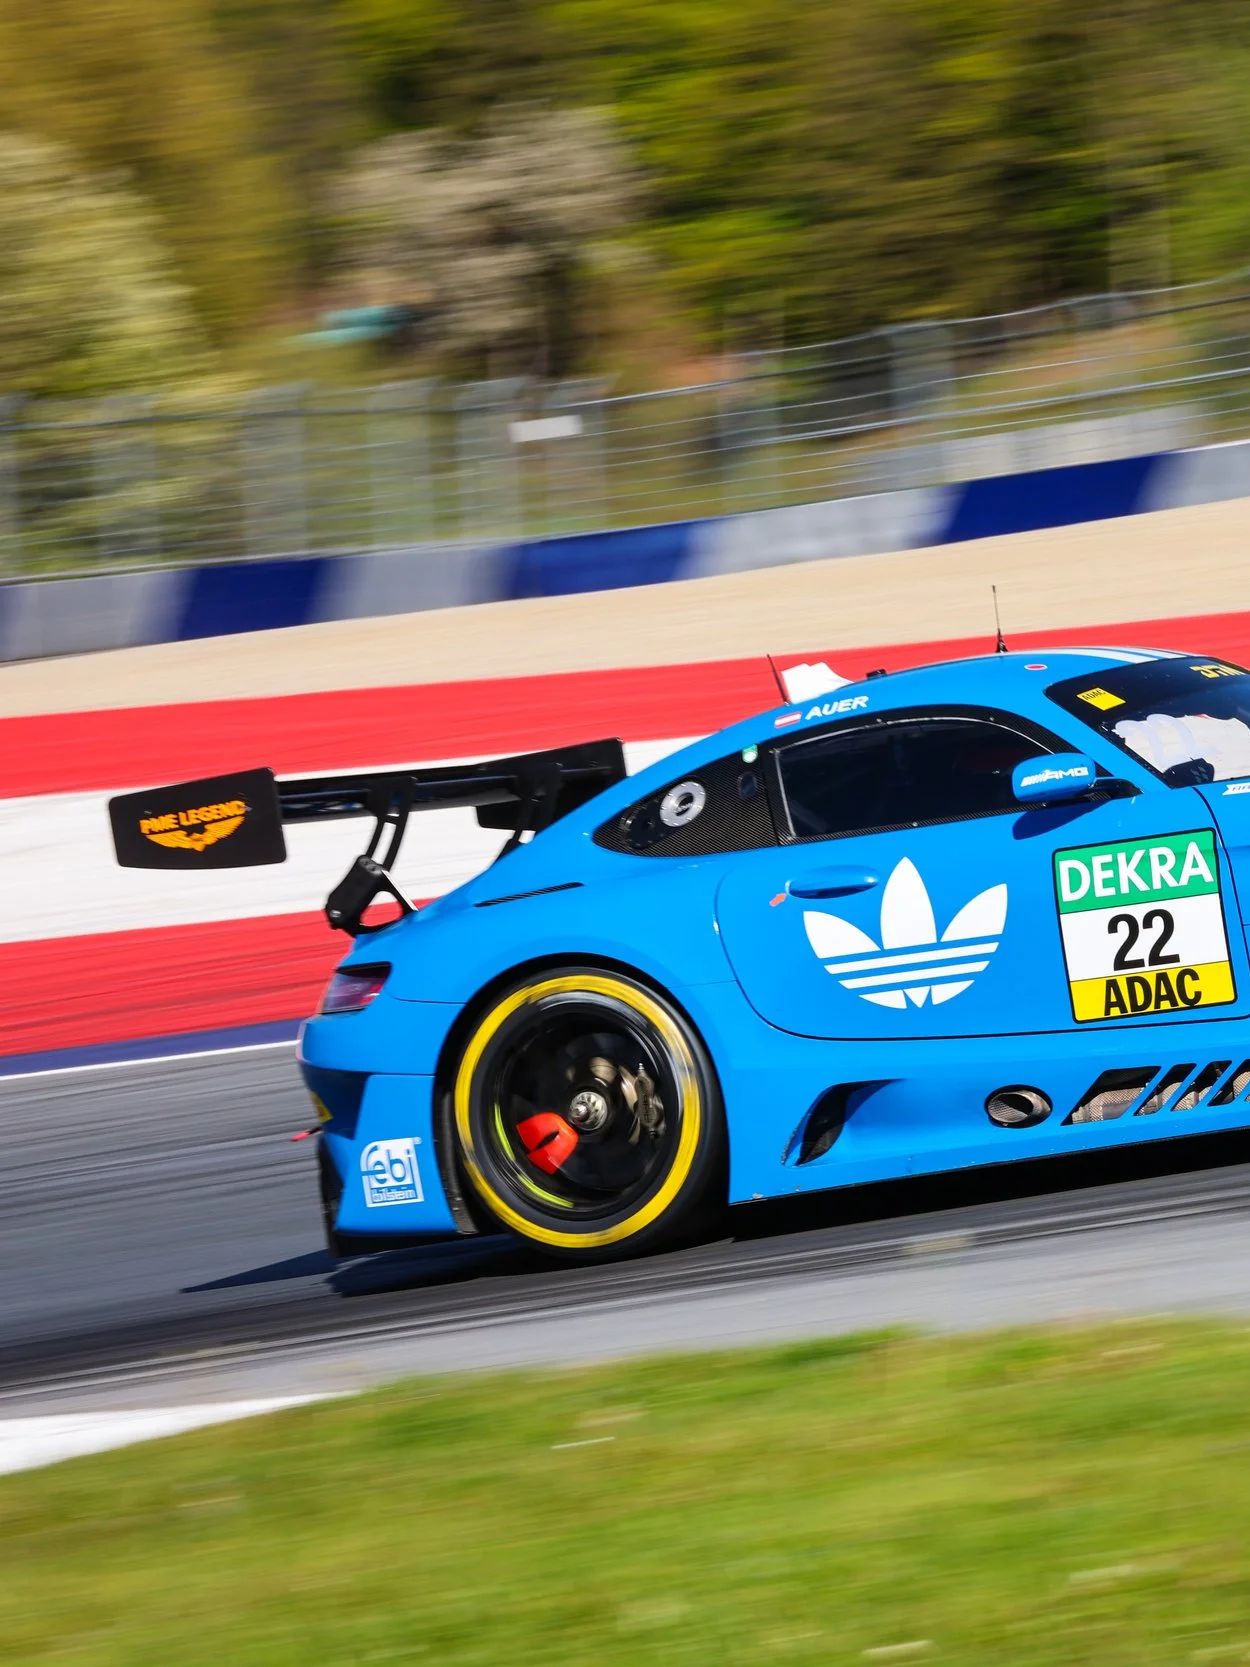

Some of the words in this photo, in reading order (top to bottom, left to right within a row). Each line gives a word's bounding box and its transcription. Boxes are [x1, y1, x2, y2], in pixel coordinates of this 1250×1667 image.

[805, 695, 869, 721] AUER
[1059, 841, 1214, 902] DEKRA
[1107, 908, 1180, 971] 22
[1104, 967, 1202, 1017] ADAC
